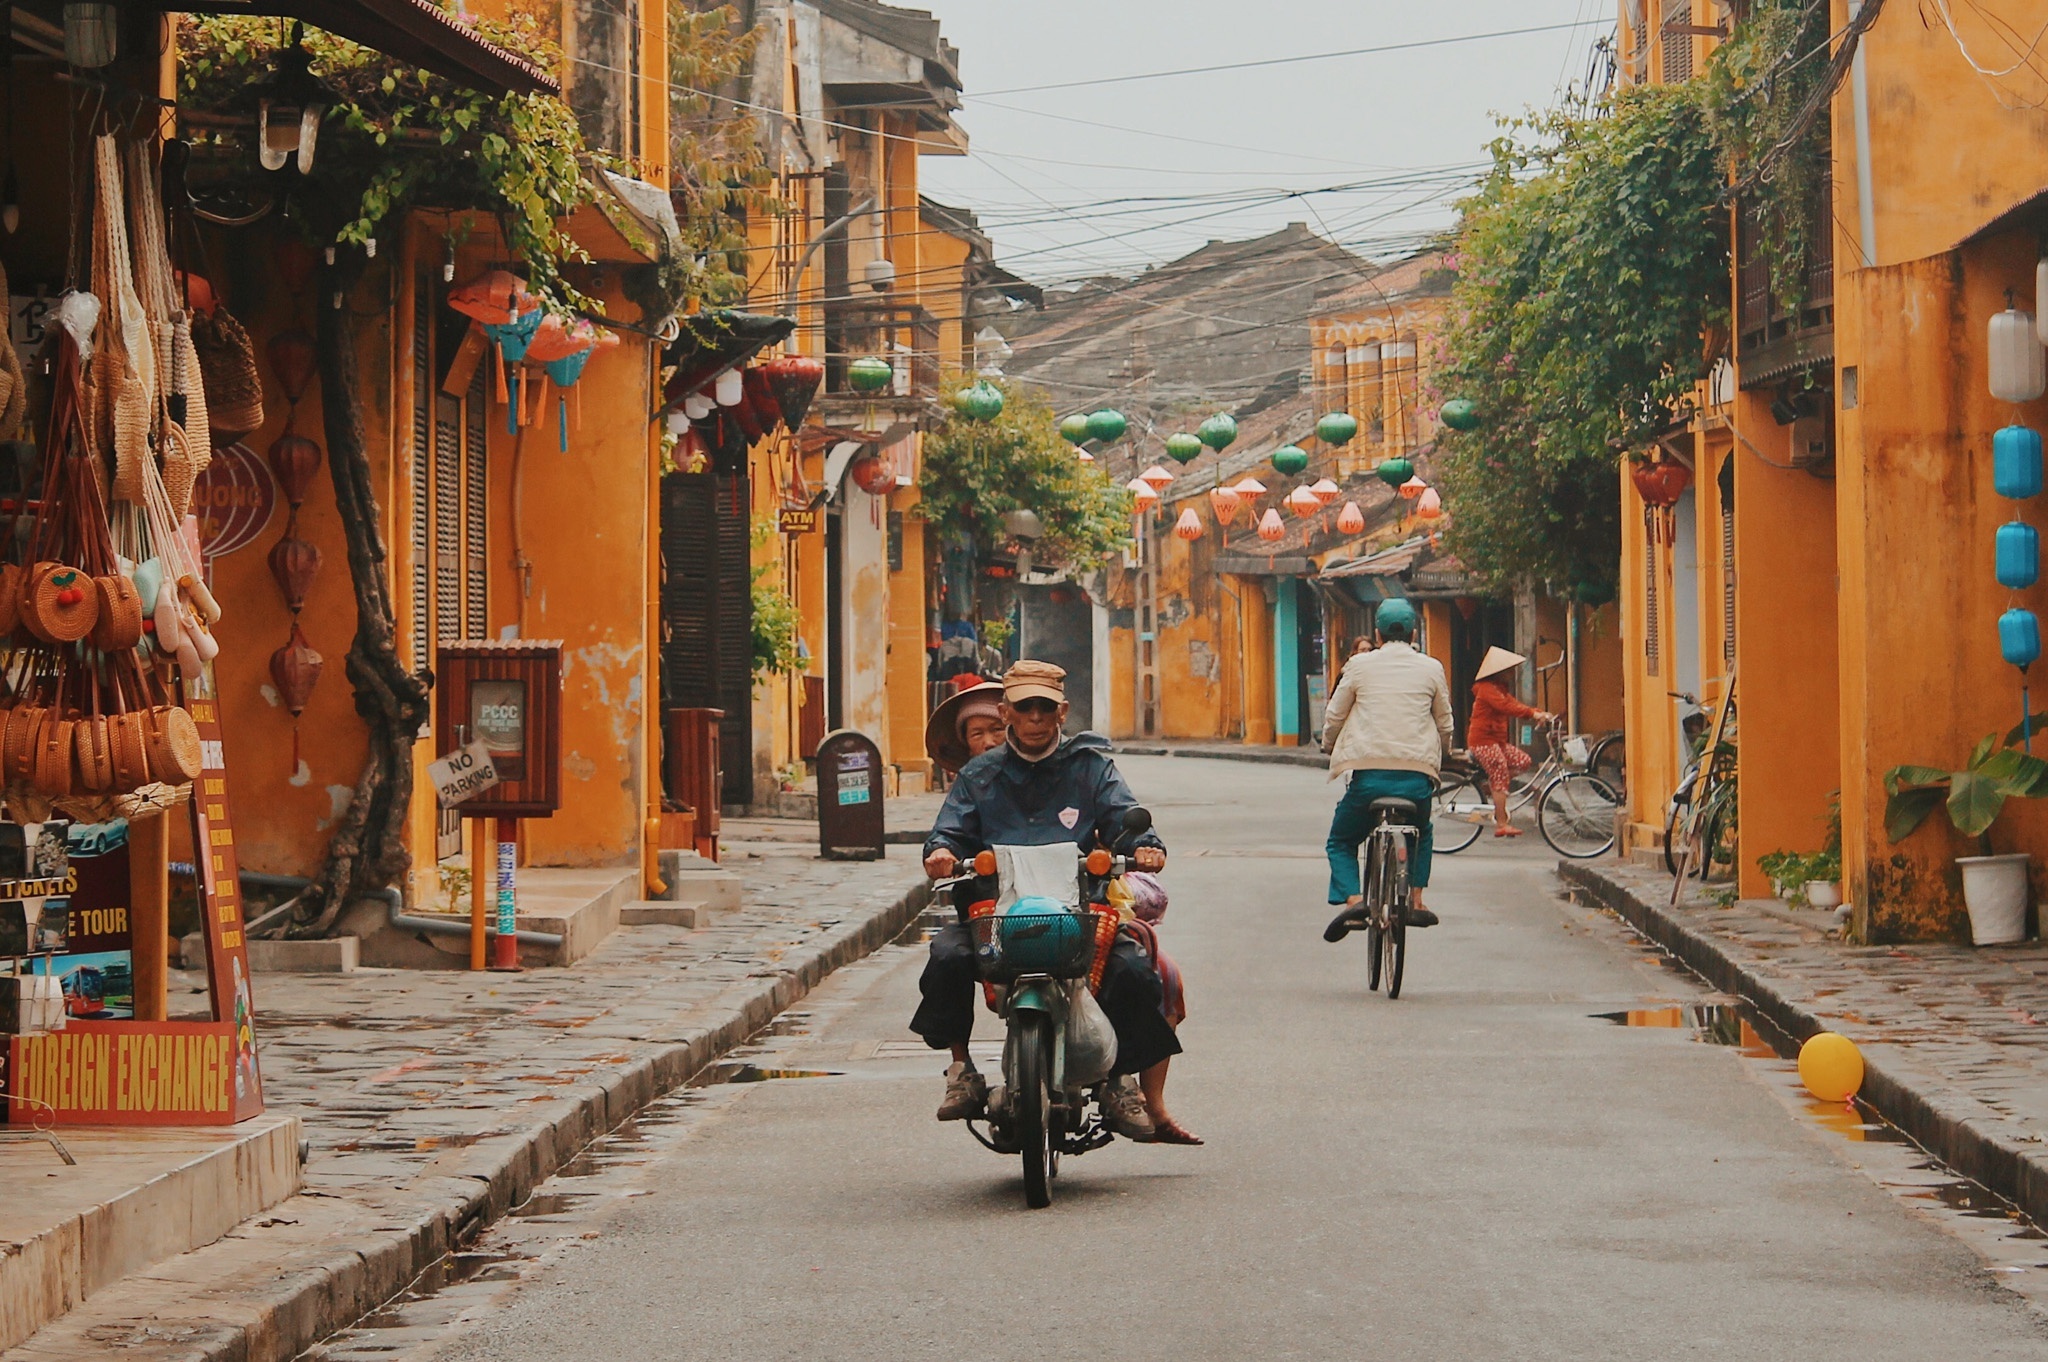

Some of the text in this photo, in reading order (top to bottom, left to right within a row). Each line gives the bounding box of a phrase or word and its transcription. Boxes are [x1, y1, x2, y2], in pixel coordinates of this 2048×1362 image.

[781, 512, 813, 524] ATM
[482, 705, 518, 718] PCCC
[448, 754, 473, 774] NO
[441, 766, 493, 800] PARKING
[81, 908, 127, 935] TOUR
[17, 1033, 110, 1111] FOREIGN
[117, 1033, 230, 1112] EXCHANGE
